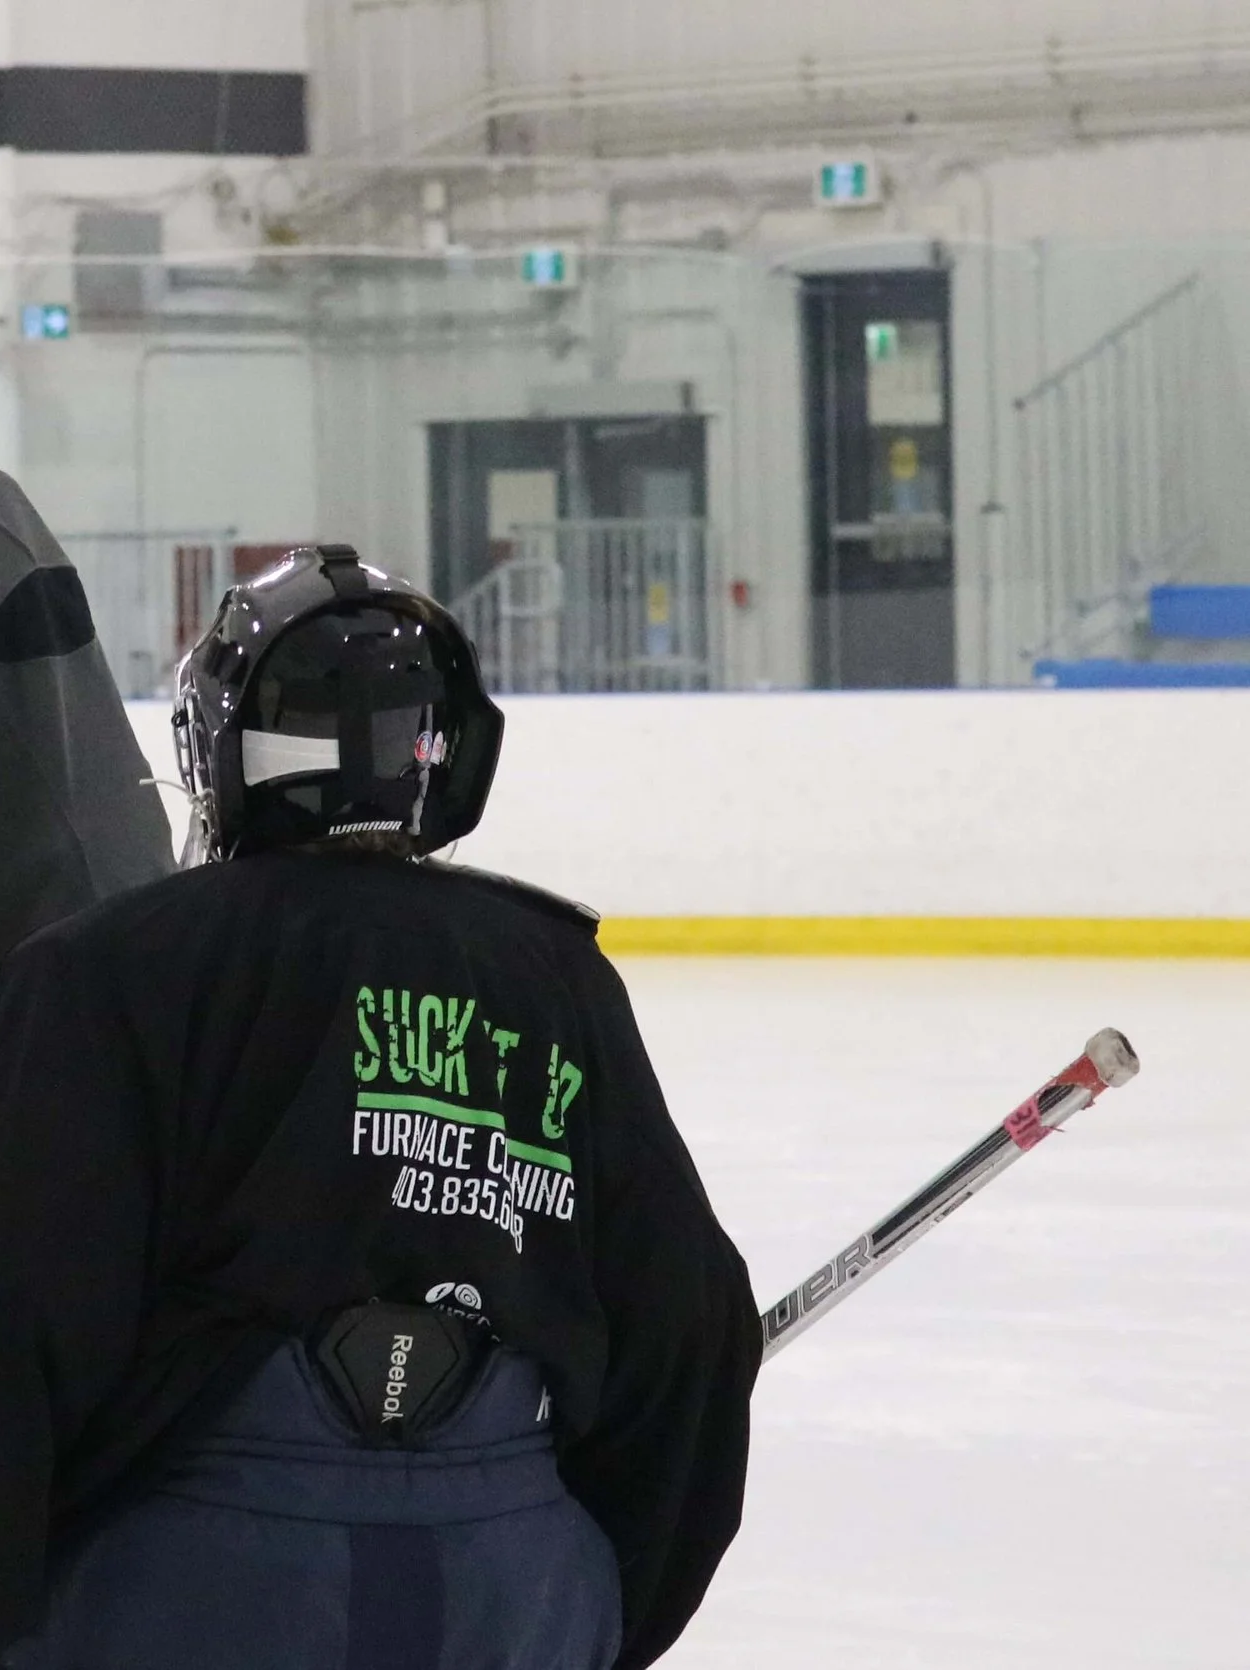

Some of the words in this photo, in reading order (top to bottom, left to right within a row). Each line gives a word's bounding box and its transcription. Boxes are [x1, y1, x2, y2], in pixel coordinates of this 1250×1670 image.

[329, 821, 403, 835] WARRIOR
[354, 986, 476, 1096] SUCK
[353, 1111, 475, 1170] FURNACE
[381, 1334, 413, 1423] Reebok
